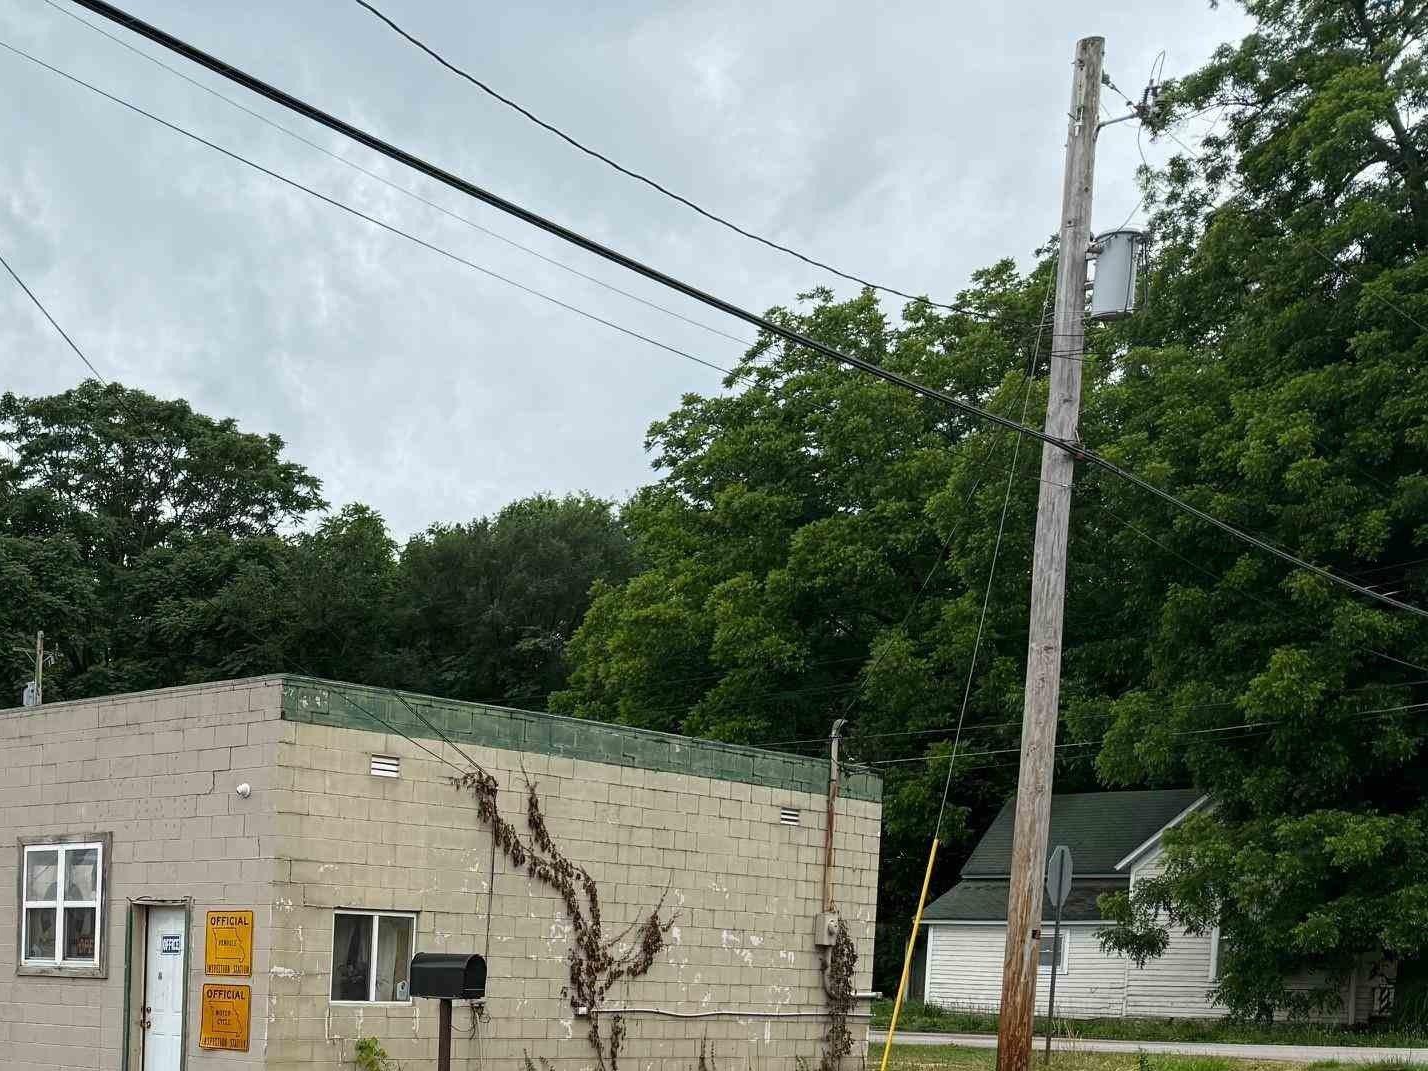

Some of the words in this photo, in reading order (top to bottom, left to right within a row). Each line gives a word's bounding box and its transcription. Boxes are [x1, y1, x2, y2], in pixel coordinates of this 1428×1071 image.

[210, 916, 249, 926] OFFICIAL
[162, 938, 180, 951] OFFICE
[206, 989, 245, 1000] OFFICIAL
